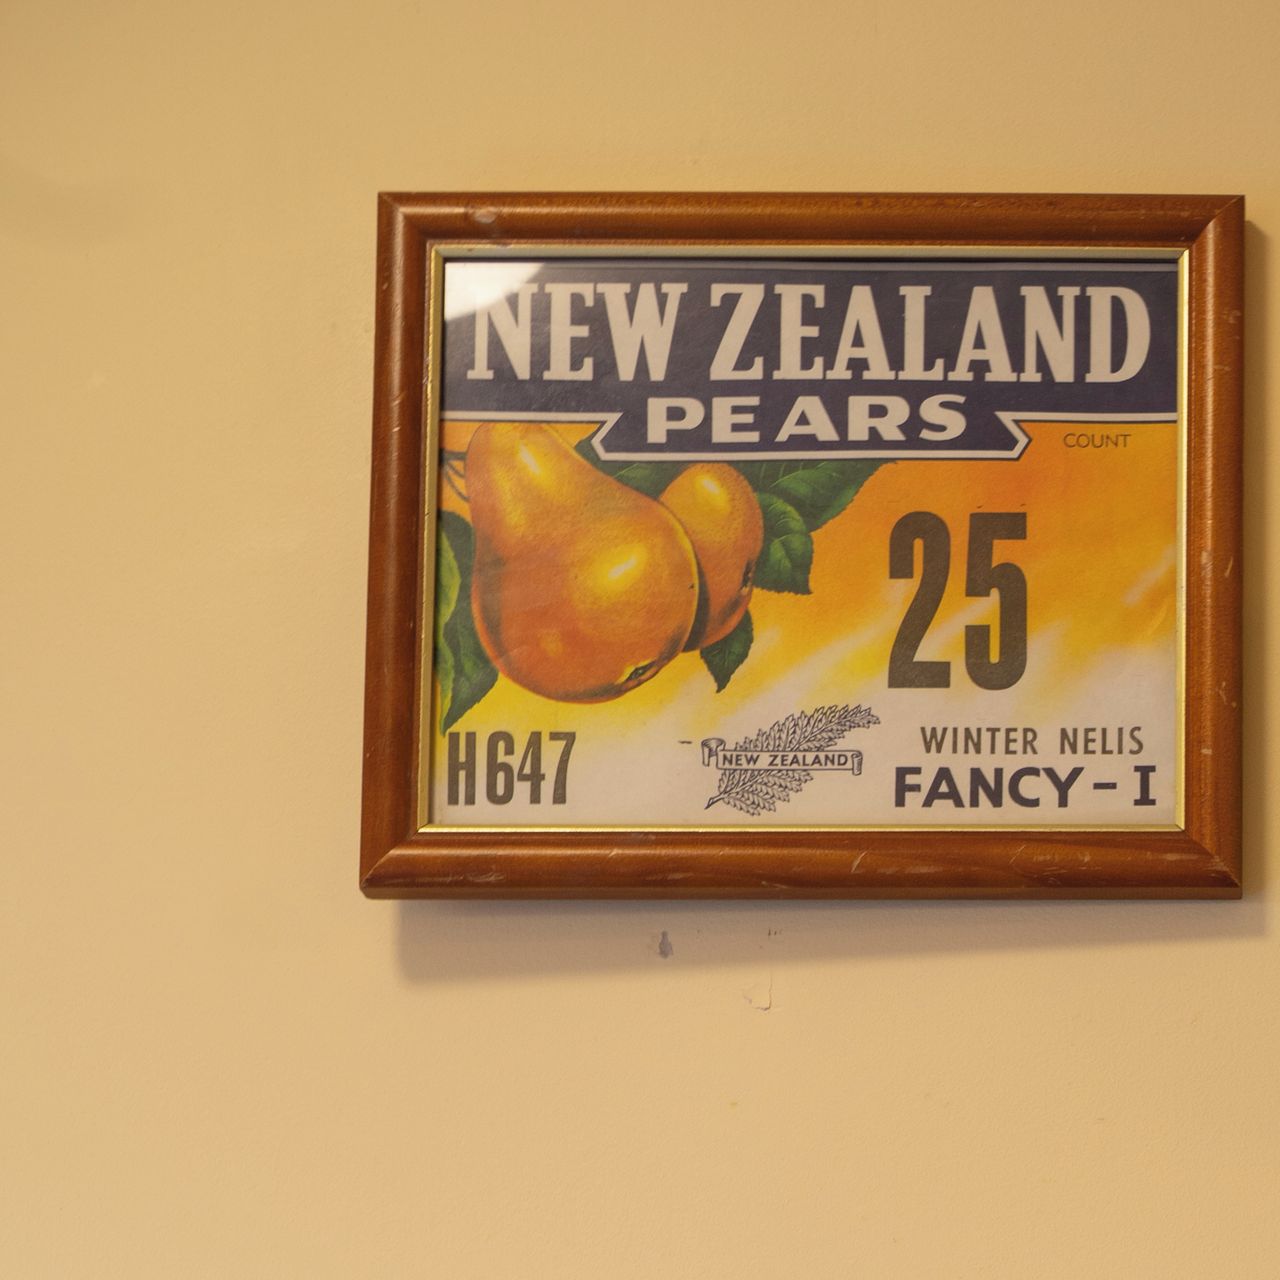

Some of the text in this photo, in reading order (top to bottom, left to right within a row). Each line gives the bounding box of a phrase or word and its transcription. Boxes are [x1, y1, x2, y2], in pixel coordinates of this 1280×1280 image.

[467, 282, 1150, 383] NEW ZEALAND
[647, 394, 967, 443] PEARS
[1063, 433, 1131, 448] COUNT
[888, 511, 1027, 690] 25
[722, 752, 848, 767] NEW ZEALAND
[920, 726, 1144, 755] WINTER NELIS
[447, 731, 577, 806] H647
